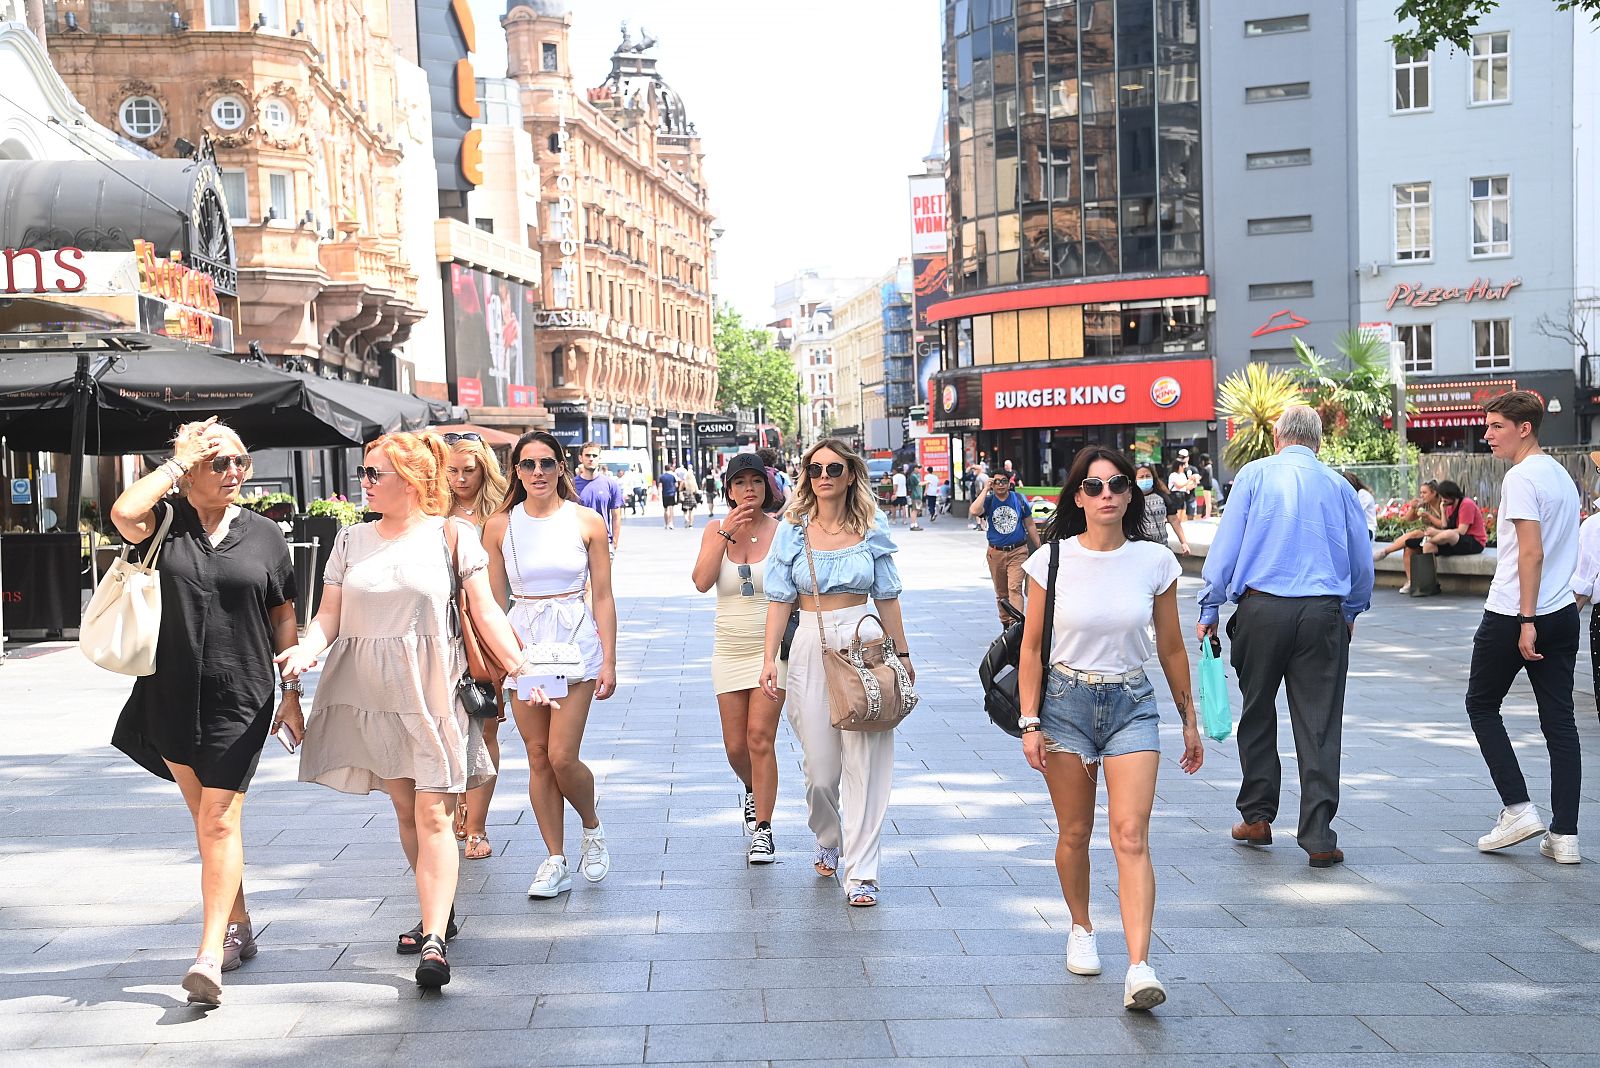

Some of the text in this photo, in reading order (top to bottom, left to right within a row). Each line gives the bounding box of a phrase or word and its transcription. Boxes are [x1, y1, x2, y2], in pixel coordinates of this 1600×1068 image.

[1385, 277, 1522, 312] Pizza Hut
[119, 388, 160, 400] Bosporus
[994, 384, 1126, 410] BURGER KING
[1415, 394, 1427, 403] ON
[1428, 393, 1437, 401] IN
[1439, 393, 1448, 401] TO
[1450, 391, 1471, 401] YOUR
[697, 423, 734, 433] CASINO
[1413, 417, 1485, 428] RESTAURAN
